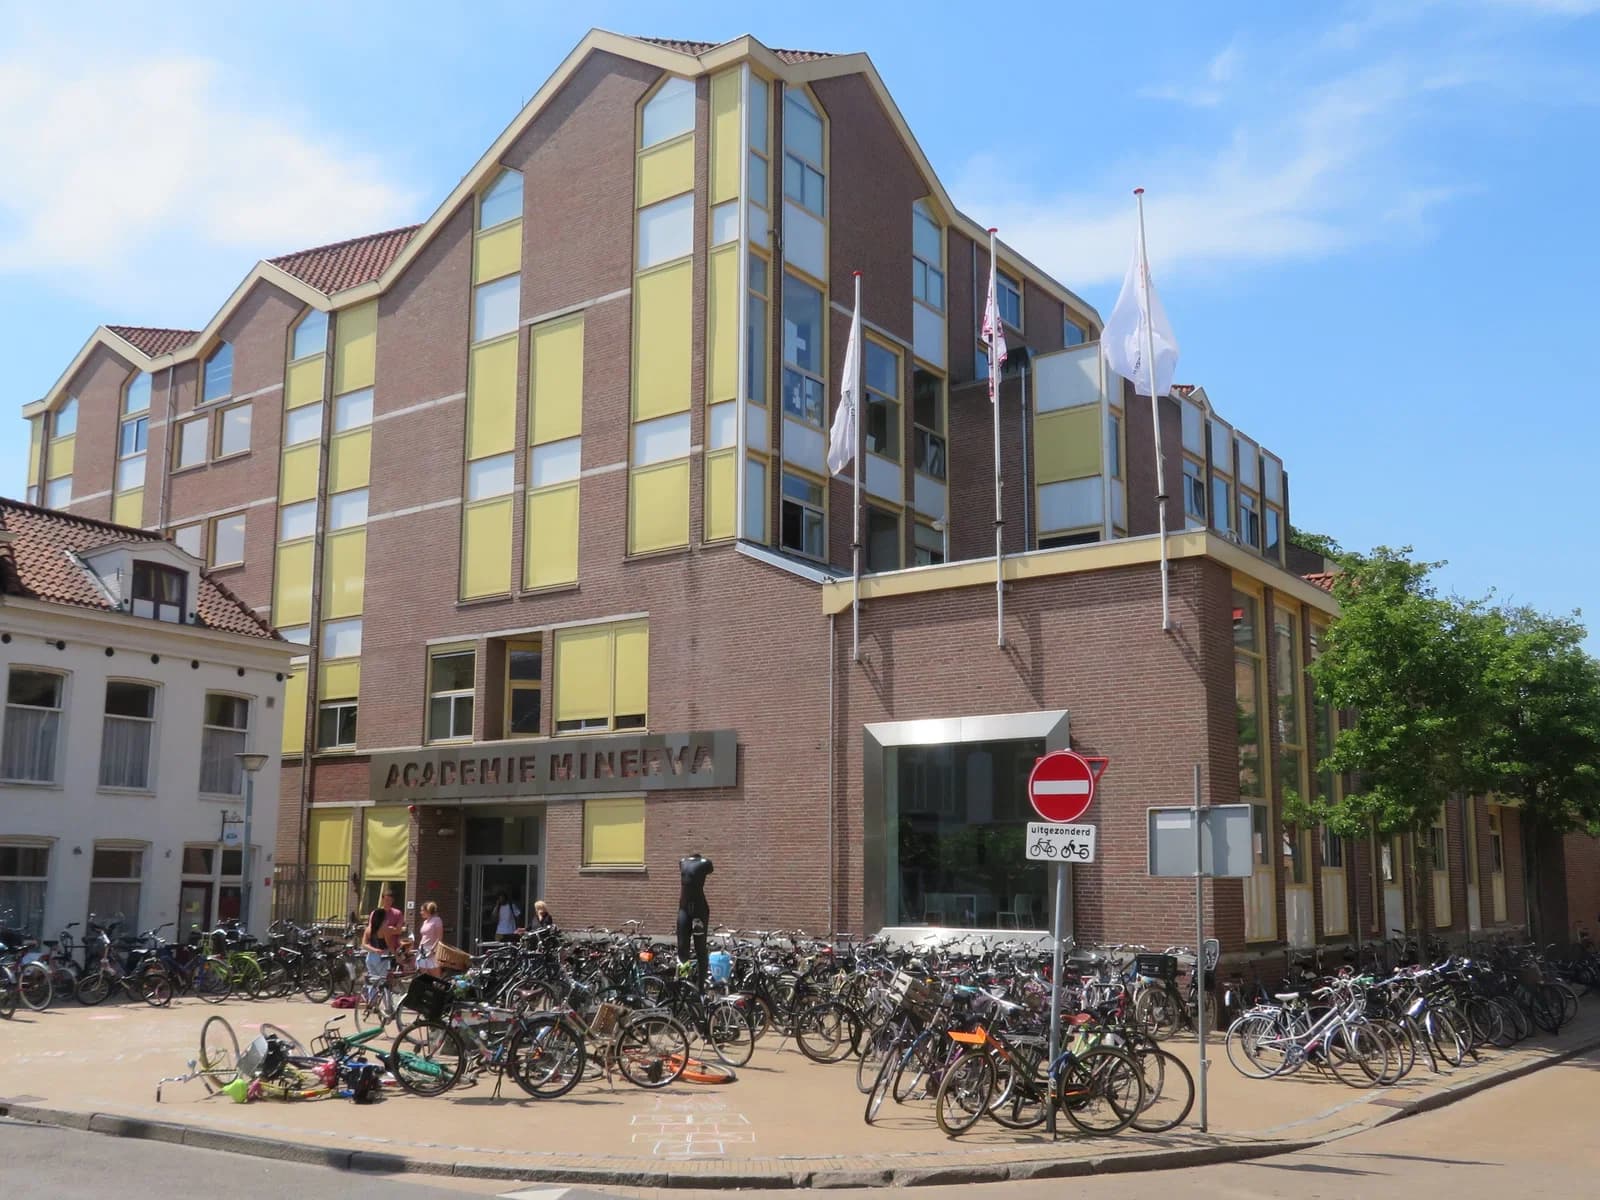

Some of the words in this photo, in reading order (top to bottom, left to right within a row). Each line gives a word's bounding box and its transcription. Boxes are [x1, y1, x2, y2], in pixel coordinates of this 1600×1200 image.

[385, 756, 536, 789] ACADEMIE
[550, 745, 713, 781] MINERVA
[1031, 826, 1091, 836] uitgezonderd
